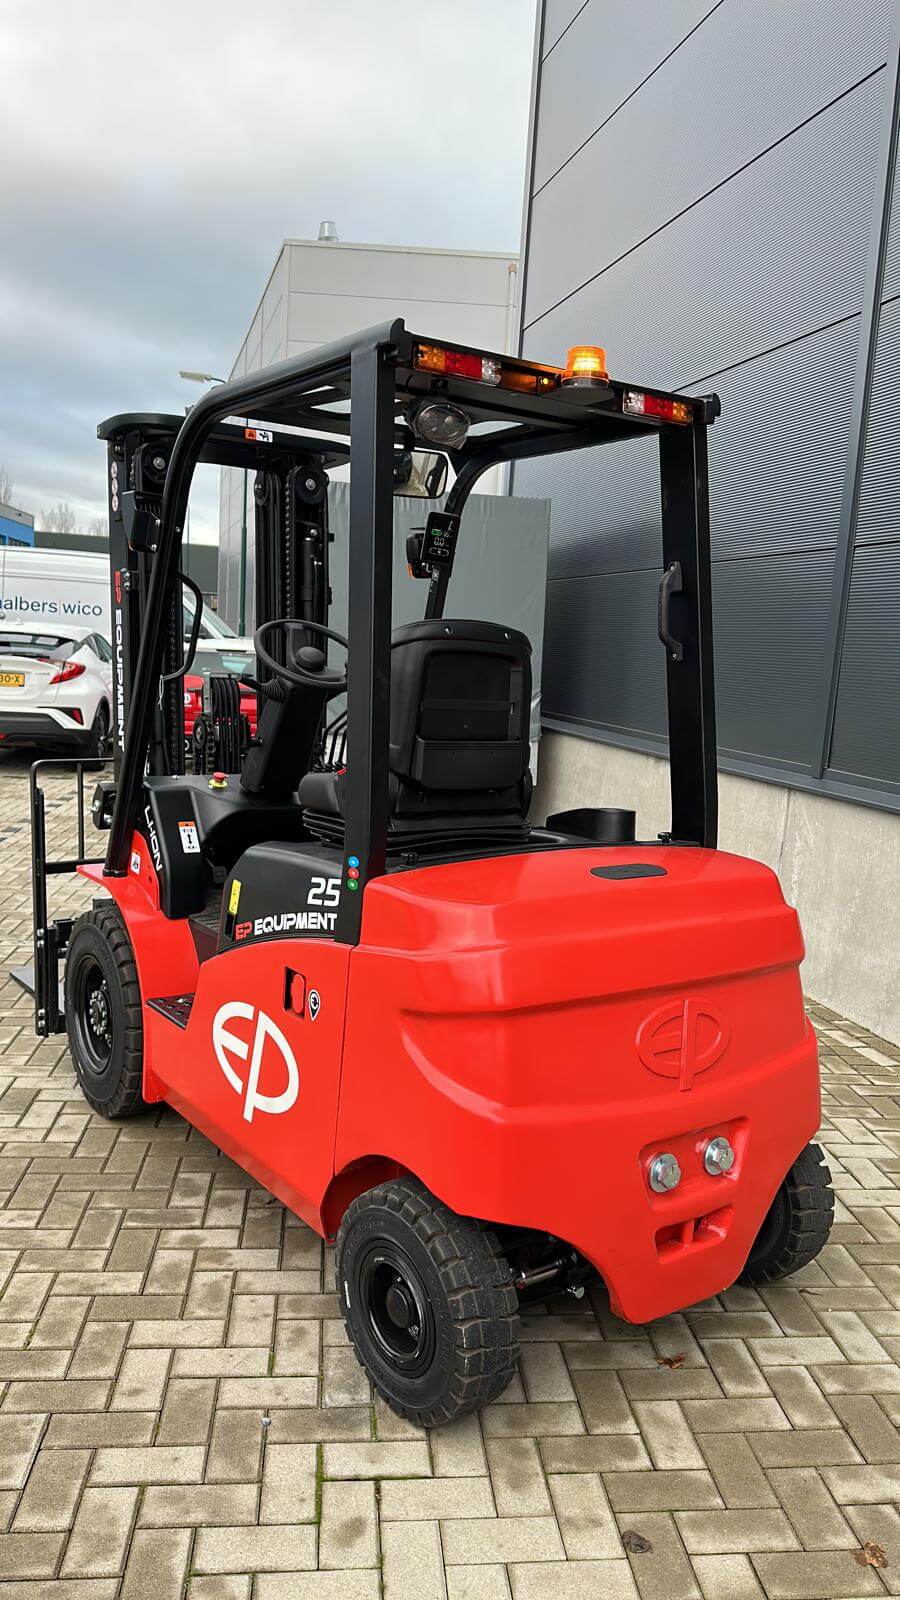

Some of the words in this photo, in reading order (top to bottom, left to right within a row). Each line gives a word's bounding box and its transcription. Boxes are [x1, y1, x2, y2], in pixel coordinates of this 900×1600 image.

[63, 601, 103, 616] wico
[115, 609, 125, 752] EQUIPMENT
[306, 876, 341, 907] 25
[235, 921, 253, 940] EP
[254, 912, 338, 935] EQUIPMENT
[212, 1001, 300, 1124] EP
